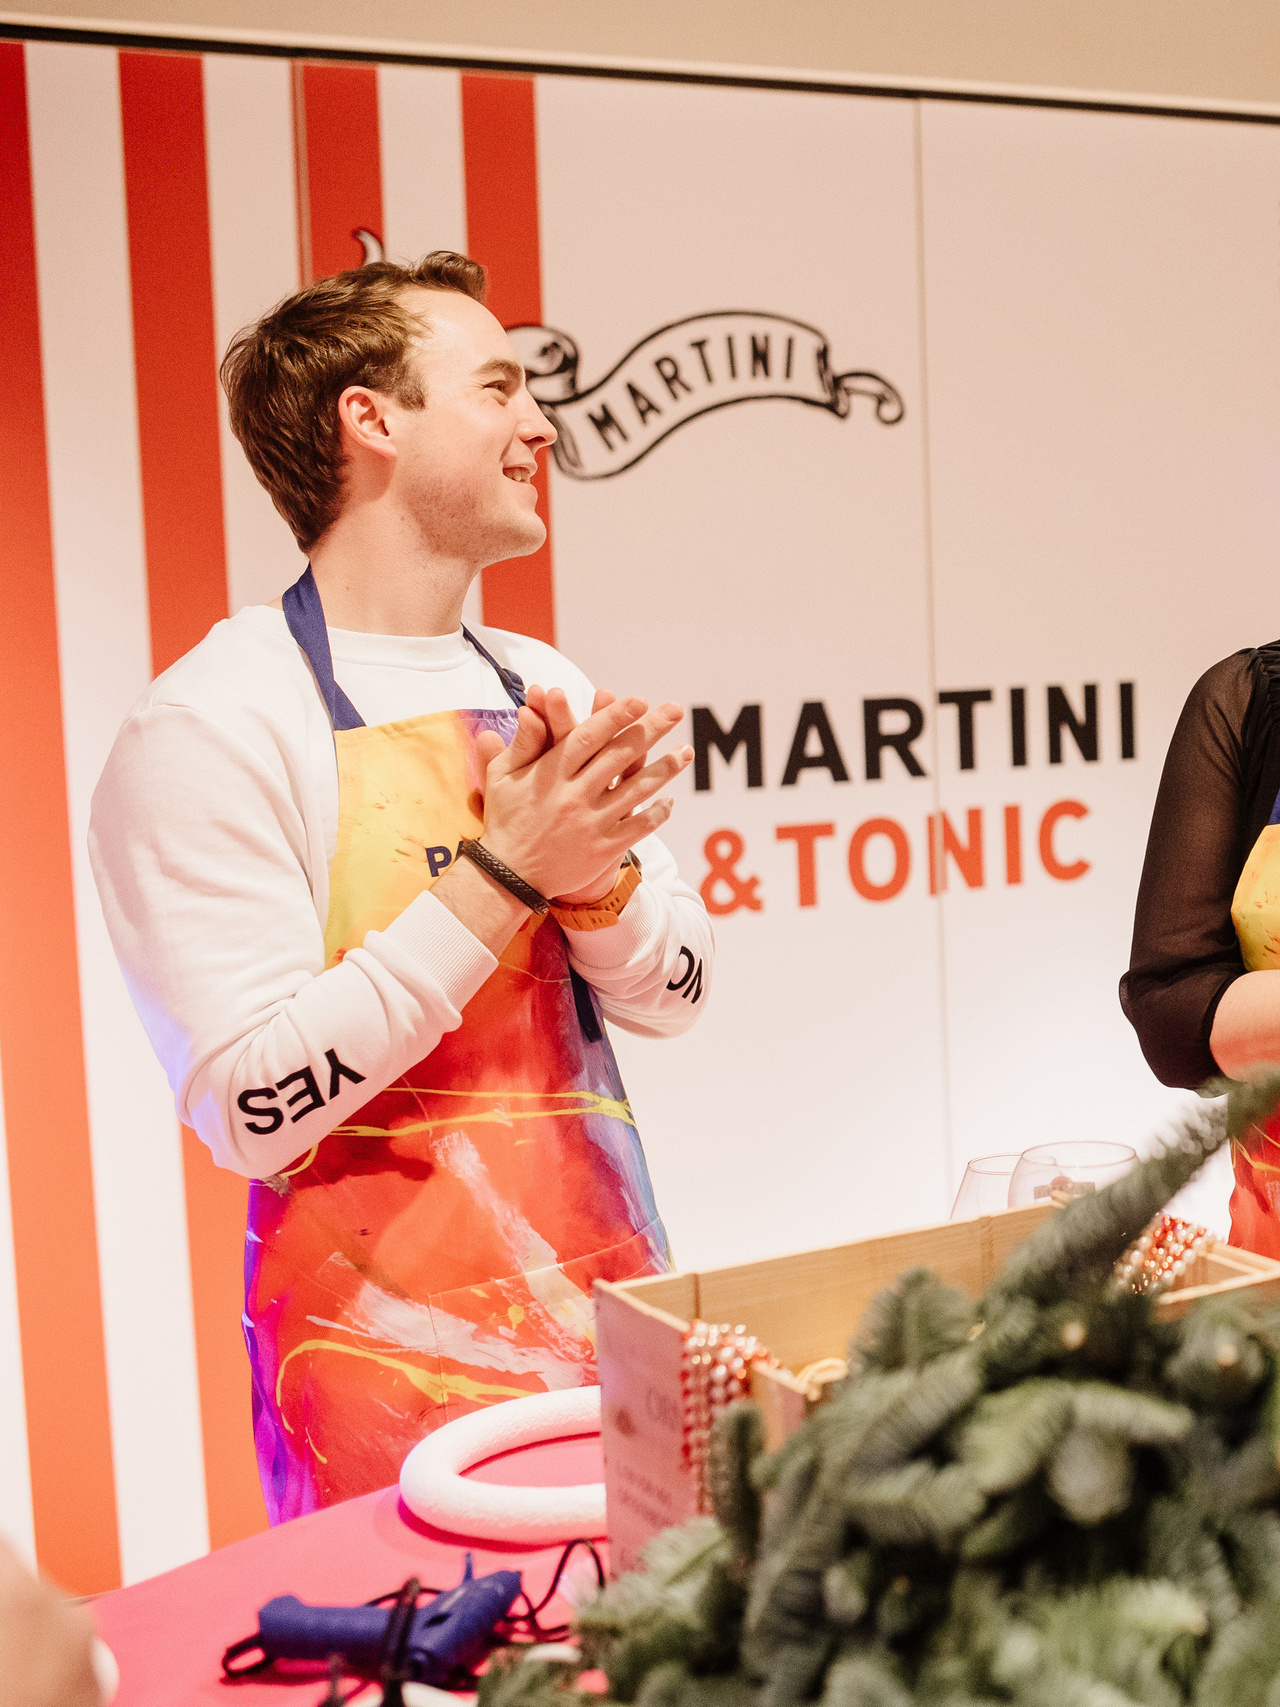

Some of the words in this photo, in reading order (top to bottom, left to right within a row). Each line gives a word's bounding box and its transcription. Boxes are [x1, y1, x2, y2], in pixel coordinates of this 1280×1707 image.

[587, 334, 794, 452] MARTINI
[690, 680, 1136, 792] MARTINI
[237, 1047, 367, 1135] YES
